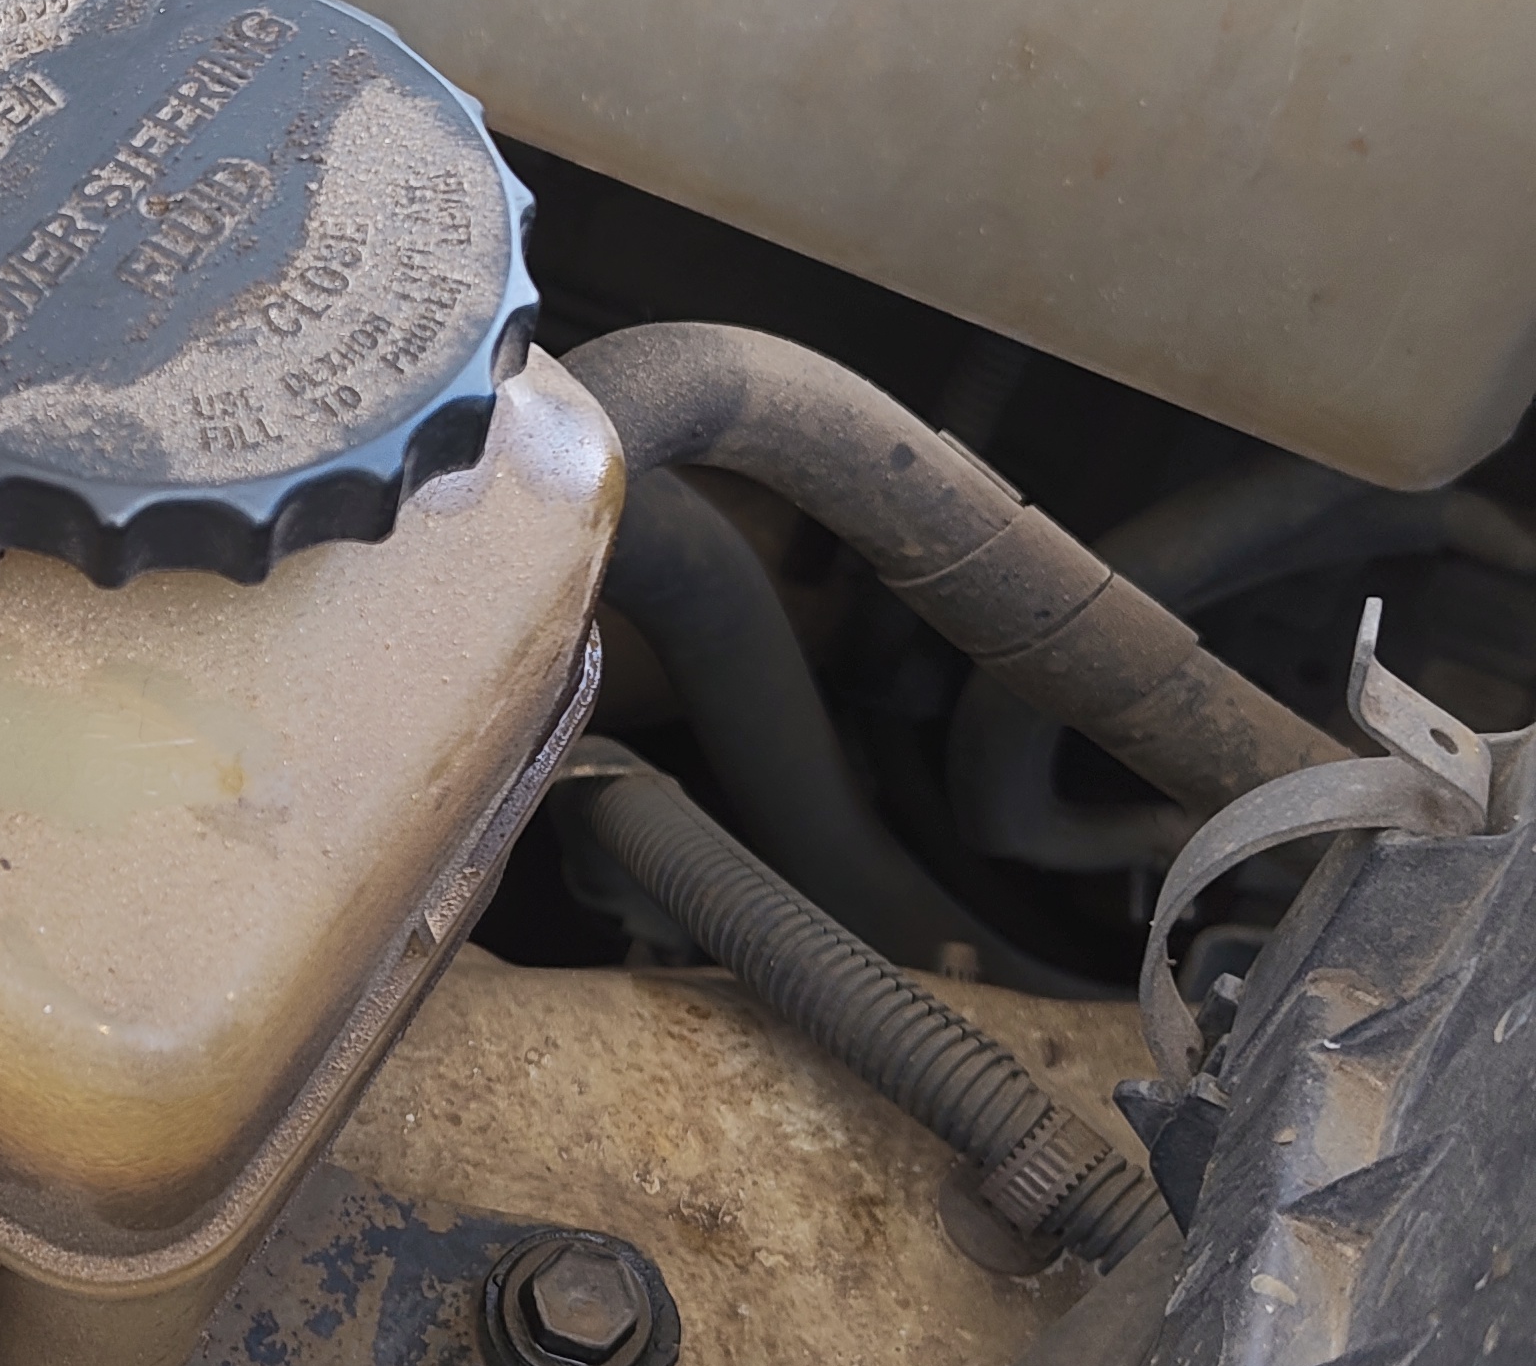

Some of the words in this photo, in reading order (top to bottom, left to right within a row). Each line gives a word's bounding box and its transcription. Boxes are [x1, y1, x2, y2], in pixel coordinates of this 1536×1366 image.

[74, 10, 295, 217] STEERING
[118, 161, 267, 294] FLUID
[264, 223, 369, 337] CLOSE
